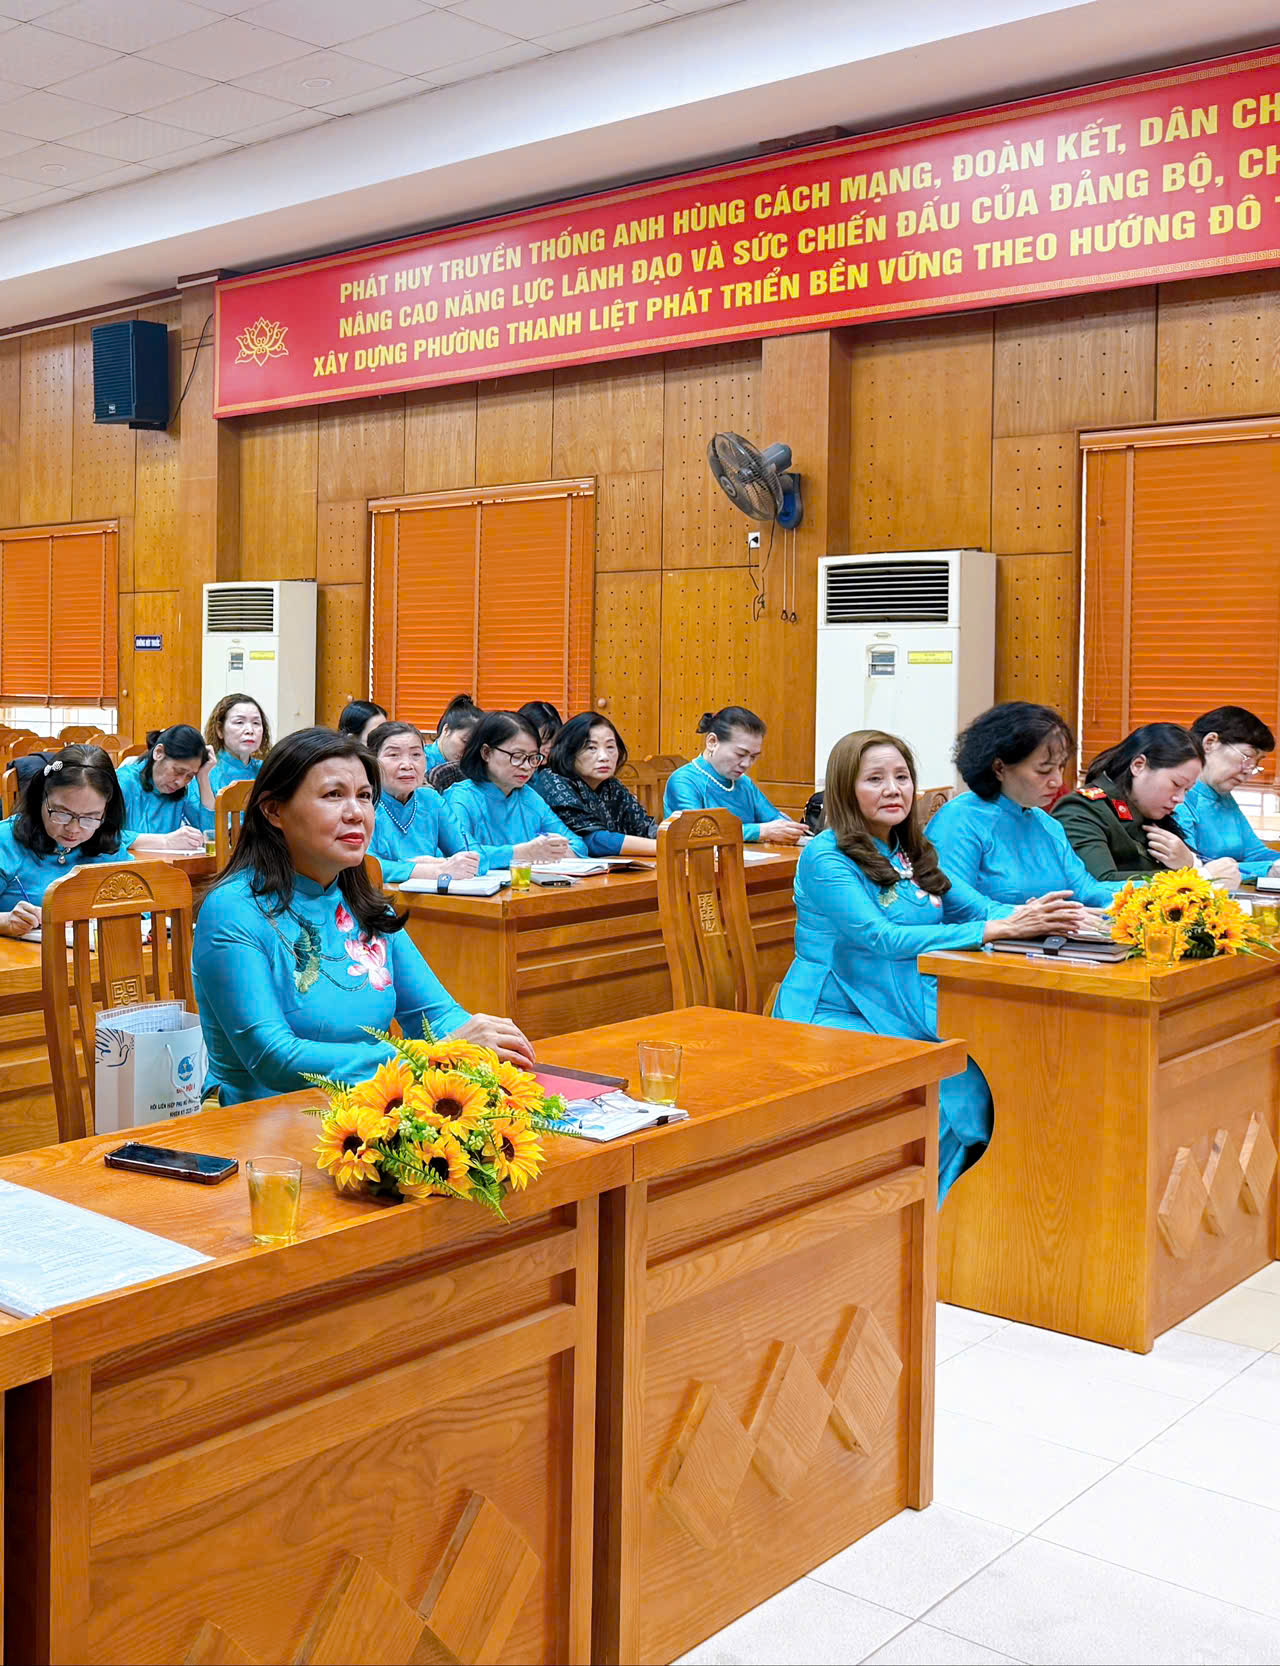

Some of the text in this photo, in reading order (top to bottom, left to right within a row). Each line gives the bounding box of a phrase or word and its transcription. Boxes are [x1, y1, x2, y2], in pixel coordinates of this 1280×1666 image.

[313, 194, 1261, 377] XÂY DỰNG PHƯỜNG THANH LIỆT PHÁT TRIỂN BỀN VỮNG THEO HƯỚNG ĐÔ
[339, 310, 392, 338] NÂNG
[399, 300, 438, 327] CAO
[445, 288, 504, 319] NĂNG
[512, 277, 554, 309] LỰC
[562, 263, 624, 297] LÃNH
[632, 252, 682, 285] ĐẠO
[691, 241, 724, 272] VÀ
[733, 231, 788, 266] SỨC
[798, 209, 886, 254] CHIẾN
[896, 195, 960, 238] ĐẤU
[972, 183, 1039, 224] CỦA
[1049, 168, 1149, 212] ĐẢNG
[1163, 151, 1224, 193] BỘ,
[340, 273, 388, 303] PHÁT
[394, 265, 433, 292] HUY
[439, 242, 521, 283] TRUYỀN
[528, 226, 605, 265] THỐNG
[613, 215, 664, 248] ANH
[673, 199, 745, 235] HÙNG
[754, 181, 830, 219] CÁCH
[840, 161, 941, 203] MẠNG,
[952, 139, 1044, 182] ĐOÀN
[1056, 118, 1126, 163] KẾT,
[1140, 104, 1218, 147] DÂN
